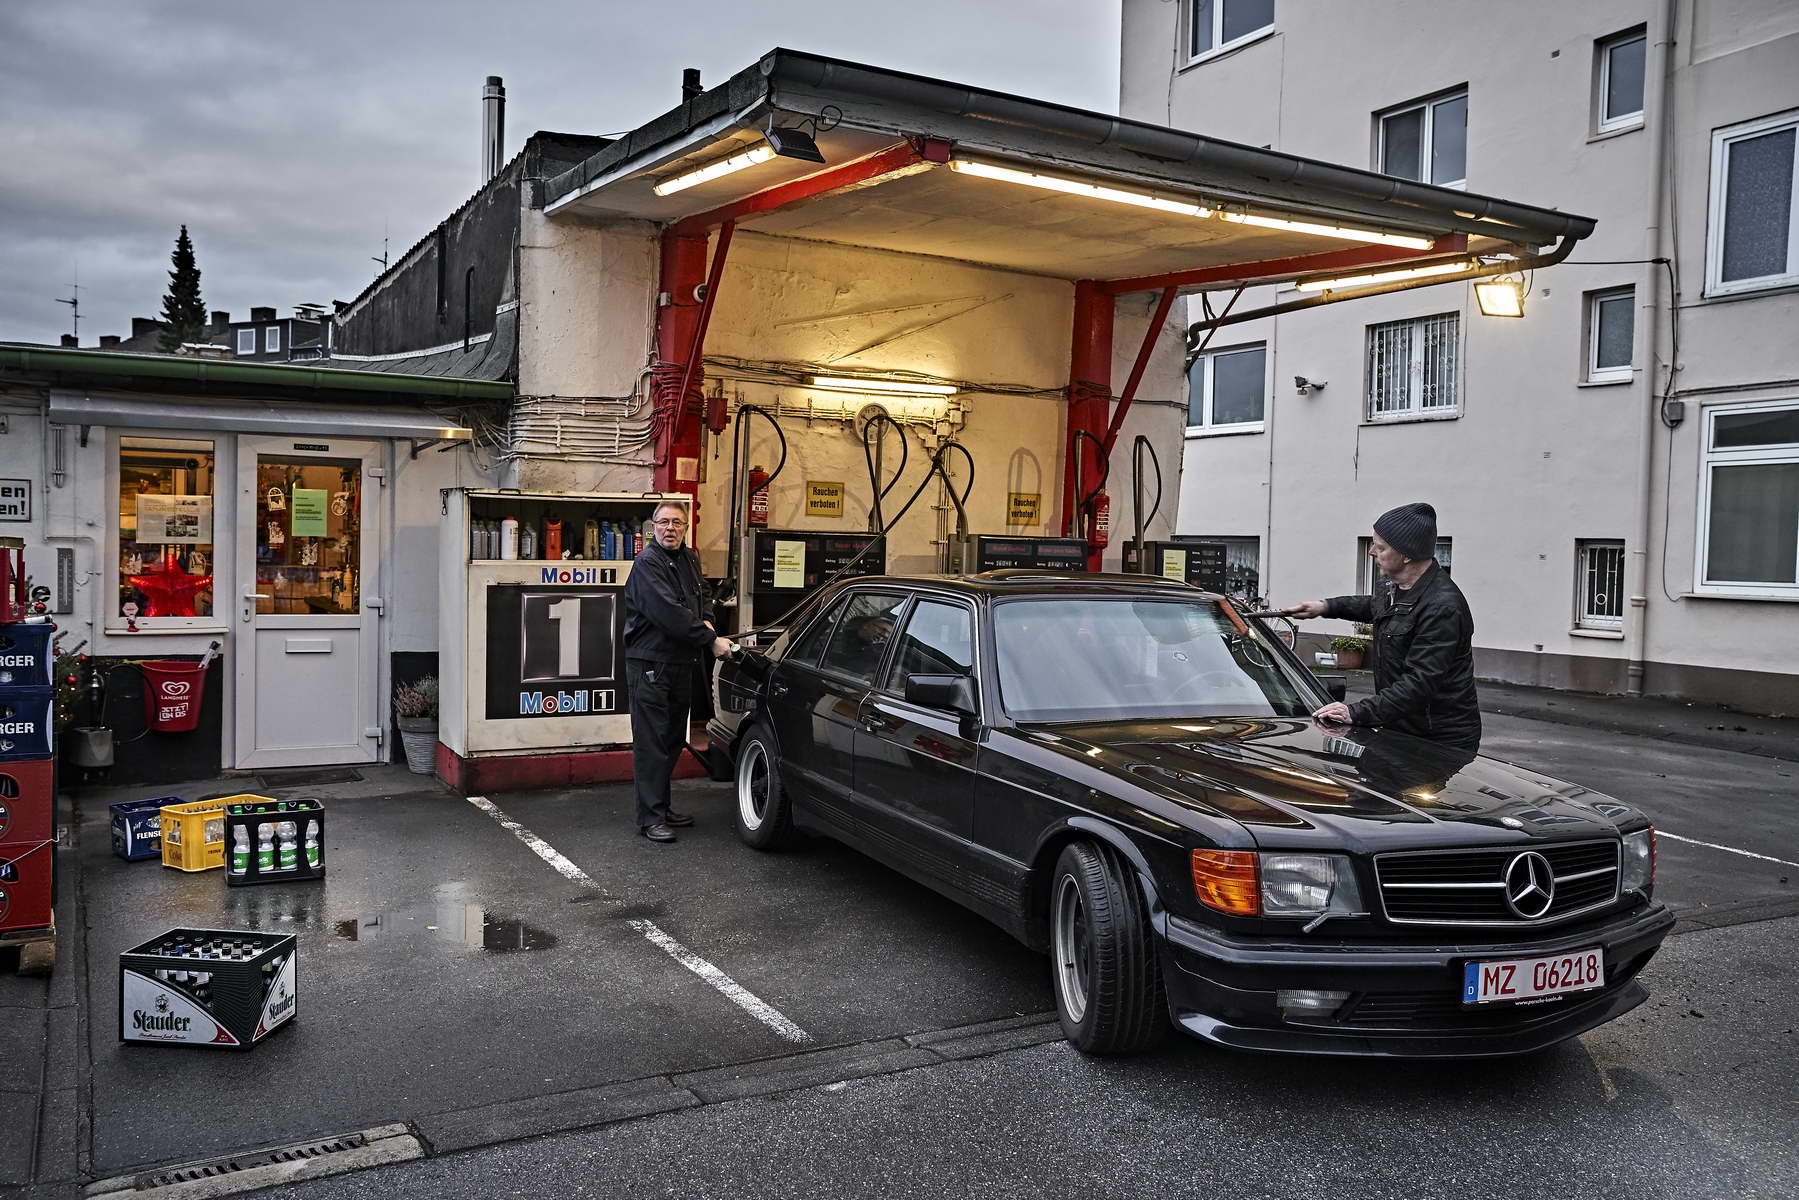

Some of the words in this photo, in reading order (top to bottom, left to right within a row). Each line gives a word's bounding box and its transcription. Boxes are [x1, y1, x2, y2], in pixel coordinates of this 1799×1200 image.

[812, 486, 839, 497] Rauchen
[810, 499, 836, 509] verboten
[541, 567, 597, 584] Mobil
[548, 597, 581, 677] 1
[519, 689, 589, 715] Mobil
[1482, 965, 1517, 996] MZ
[1533, 954, 1598, 991] 06218
[1467, 985, 1475, 995] D
[132, 1009, 191, 1032] Stauder
